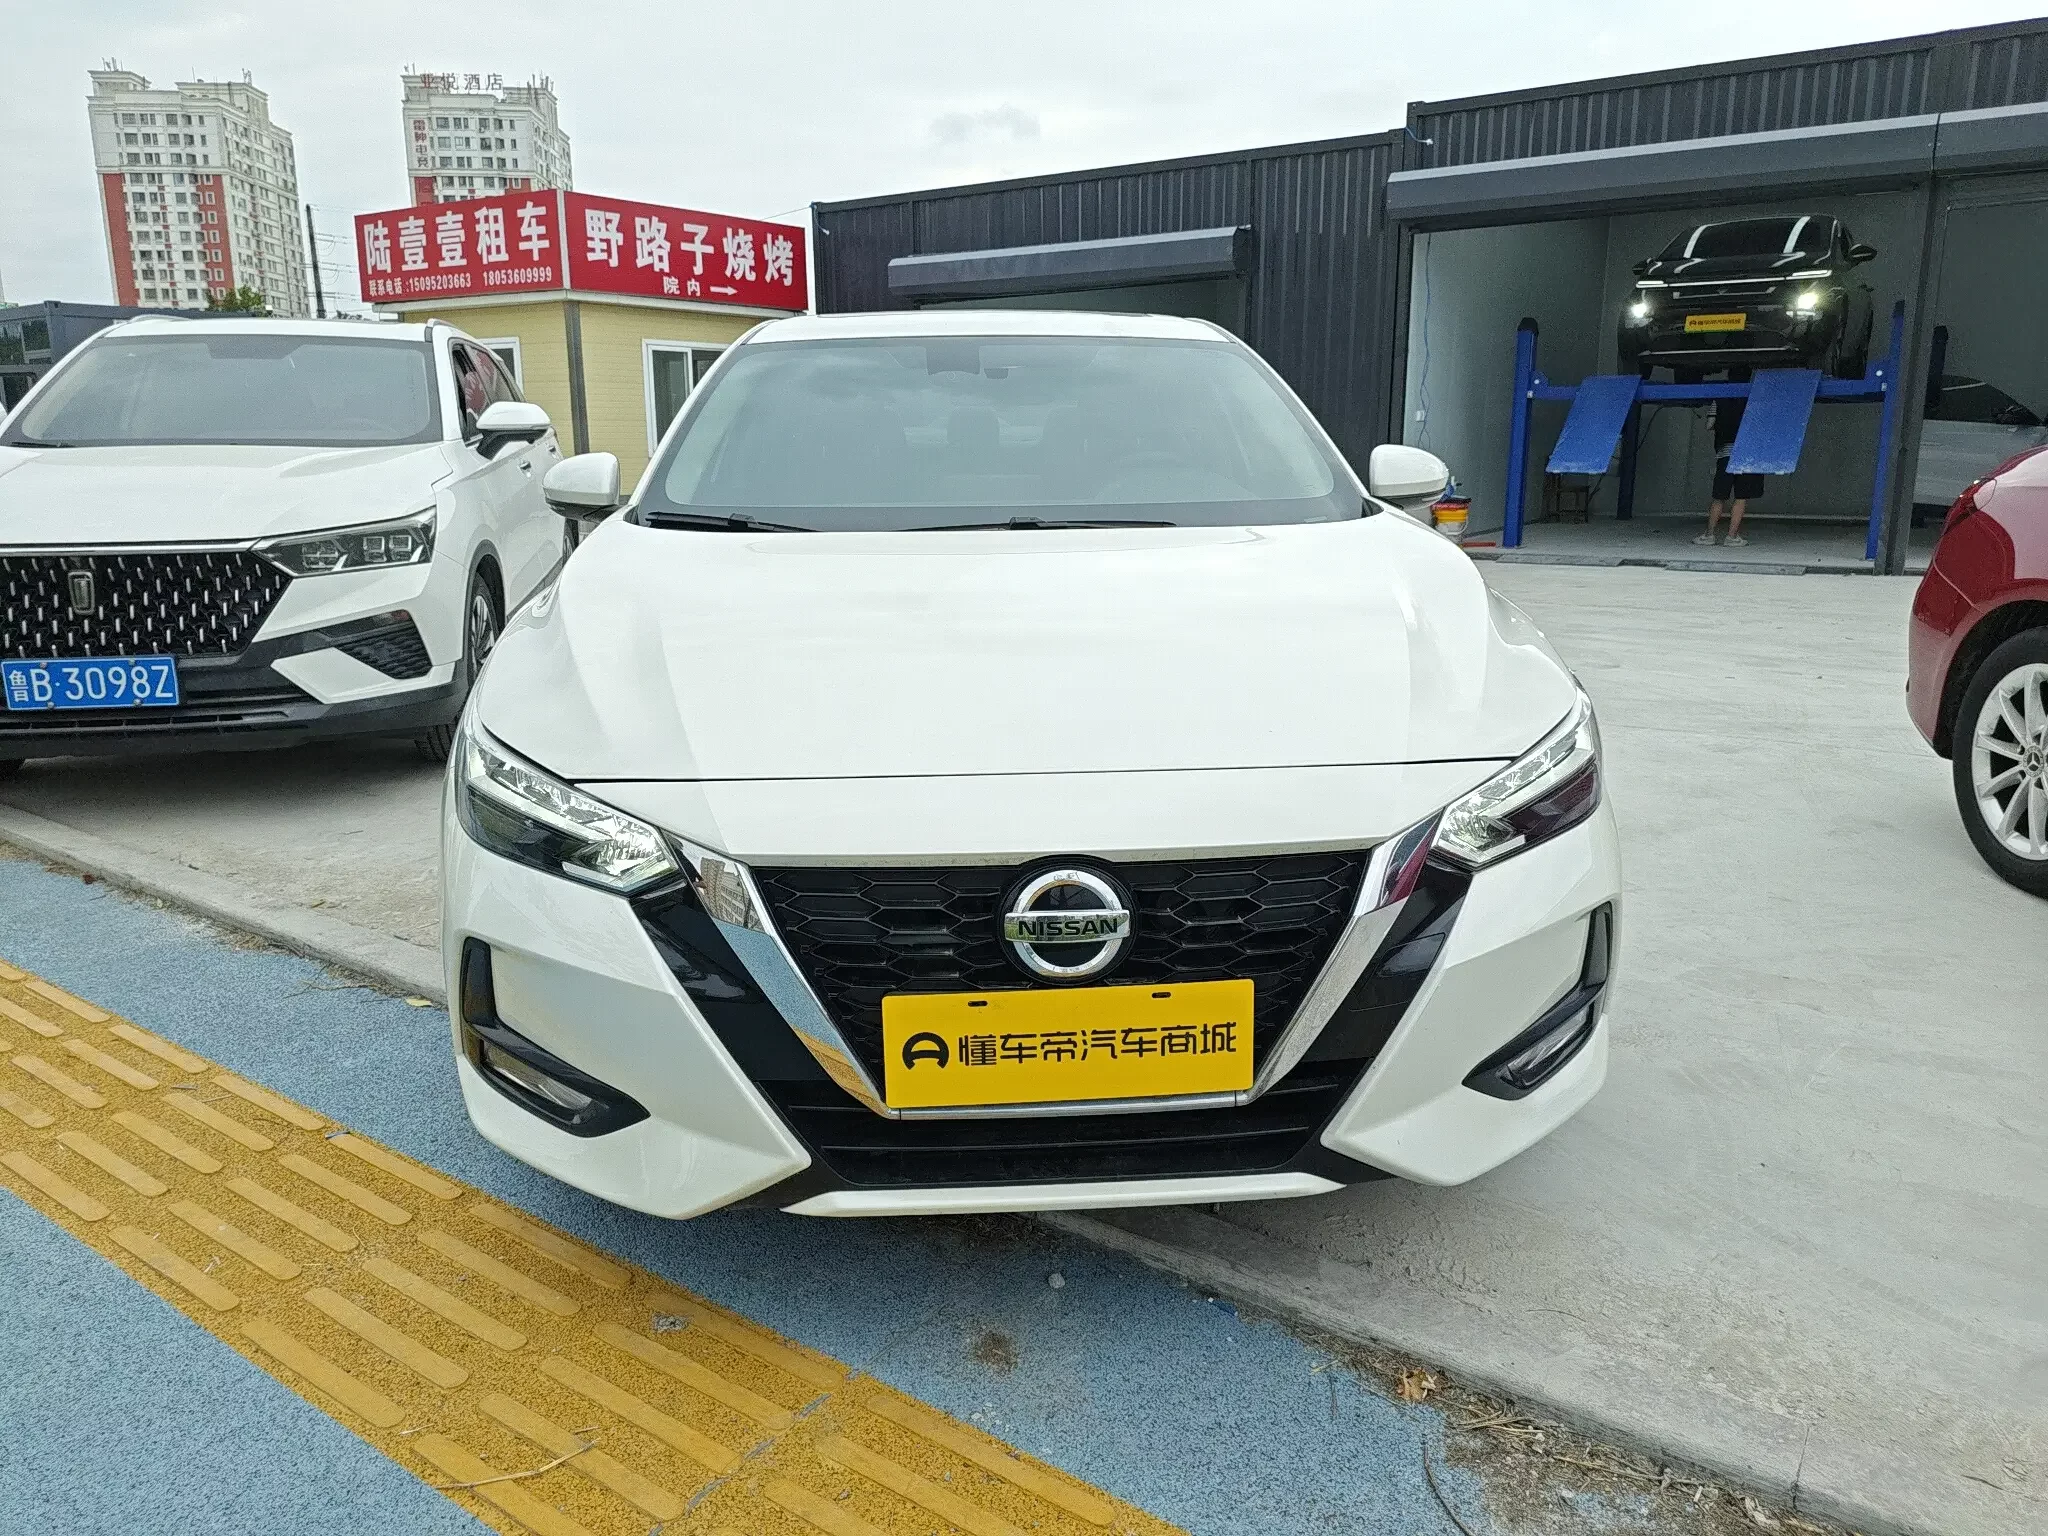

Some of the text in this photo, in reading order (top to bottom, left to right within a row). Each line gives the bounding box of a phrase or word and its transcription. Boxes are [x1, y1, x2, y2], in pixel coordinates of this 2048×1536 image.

[363, 201, 550, 275] 陆壹壹租车
[585, 208, 795, 288] 野路子烧烤
[483, 266, 552, 286] 18053609999
[662, 276, 701, 297] 院内
[1018, 918, 1118, 936] NISSAN
[958, 1021, 1237, 1067] 懂车帝汽车商城
